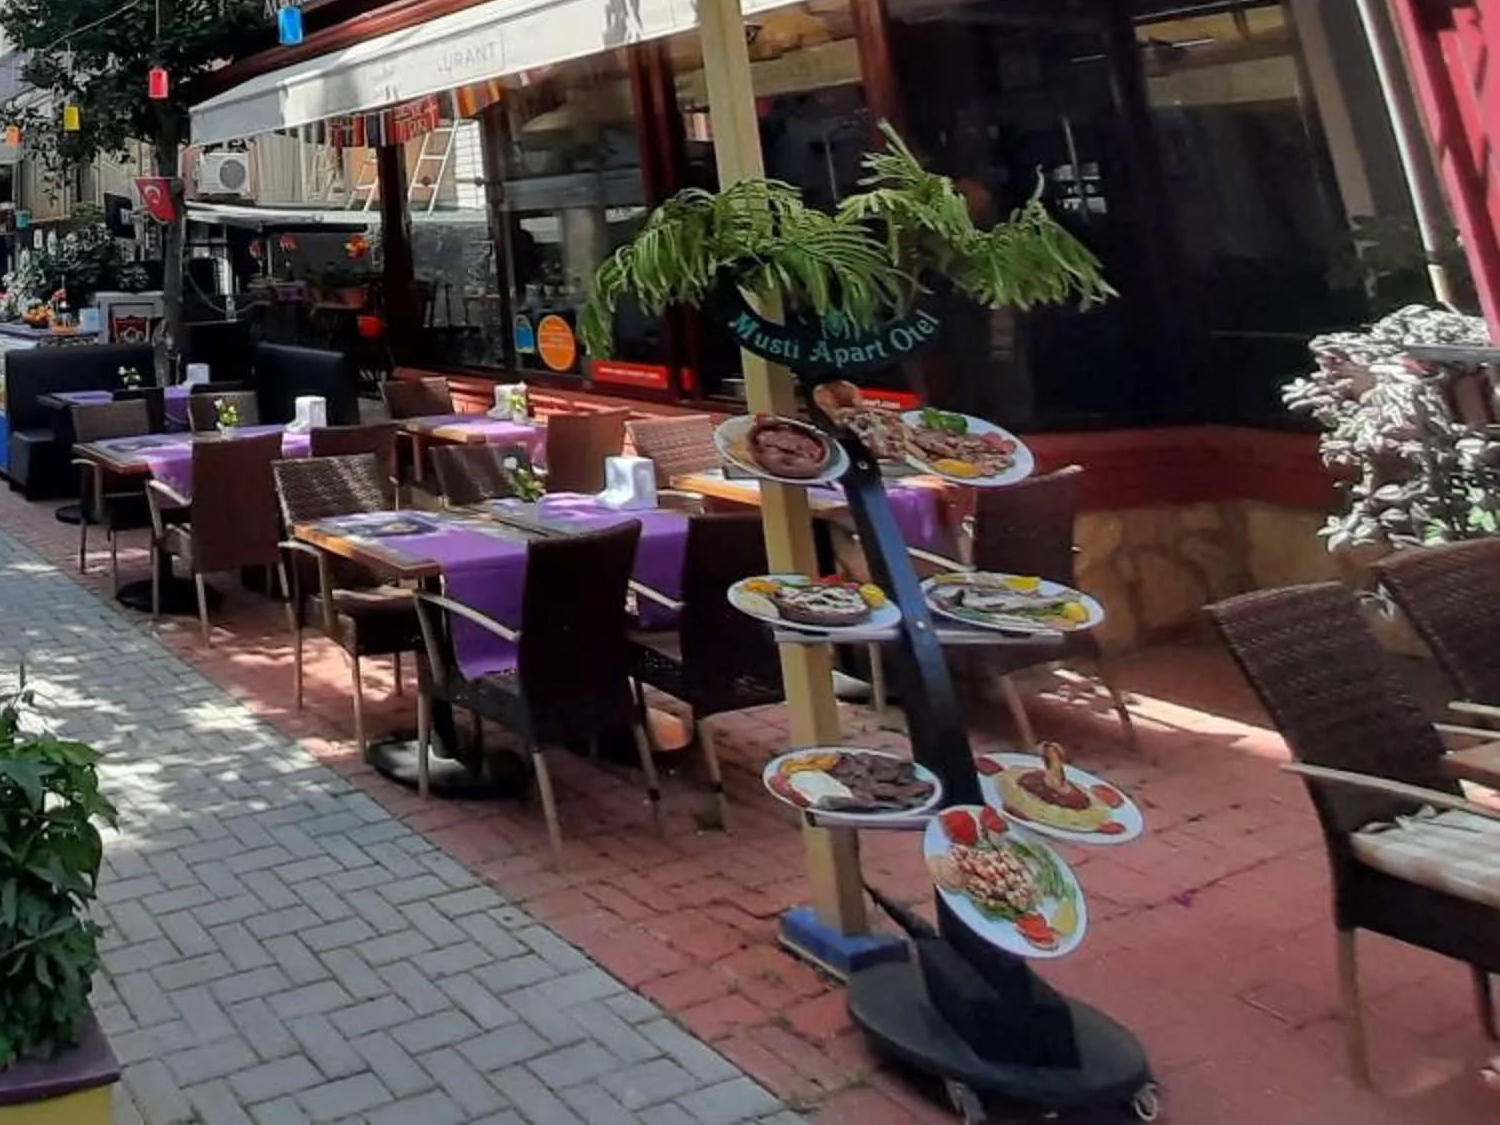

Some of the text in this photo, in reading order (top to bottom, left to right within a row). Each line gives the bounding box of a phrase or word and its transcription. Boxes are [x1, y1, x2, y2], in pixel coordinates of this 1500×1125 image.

[728, 310, 800, 360] Musti
[808, 339, 890, 368] Apart
[889, 307, 941, 352] Otel
